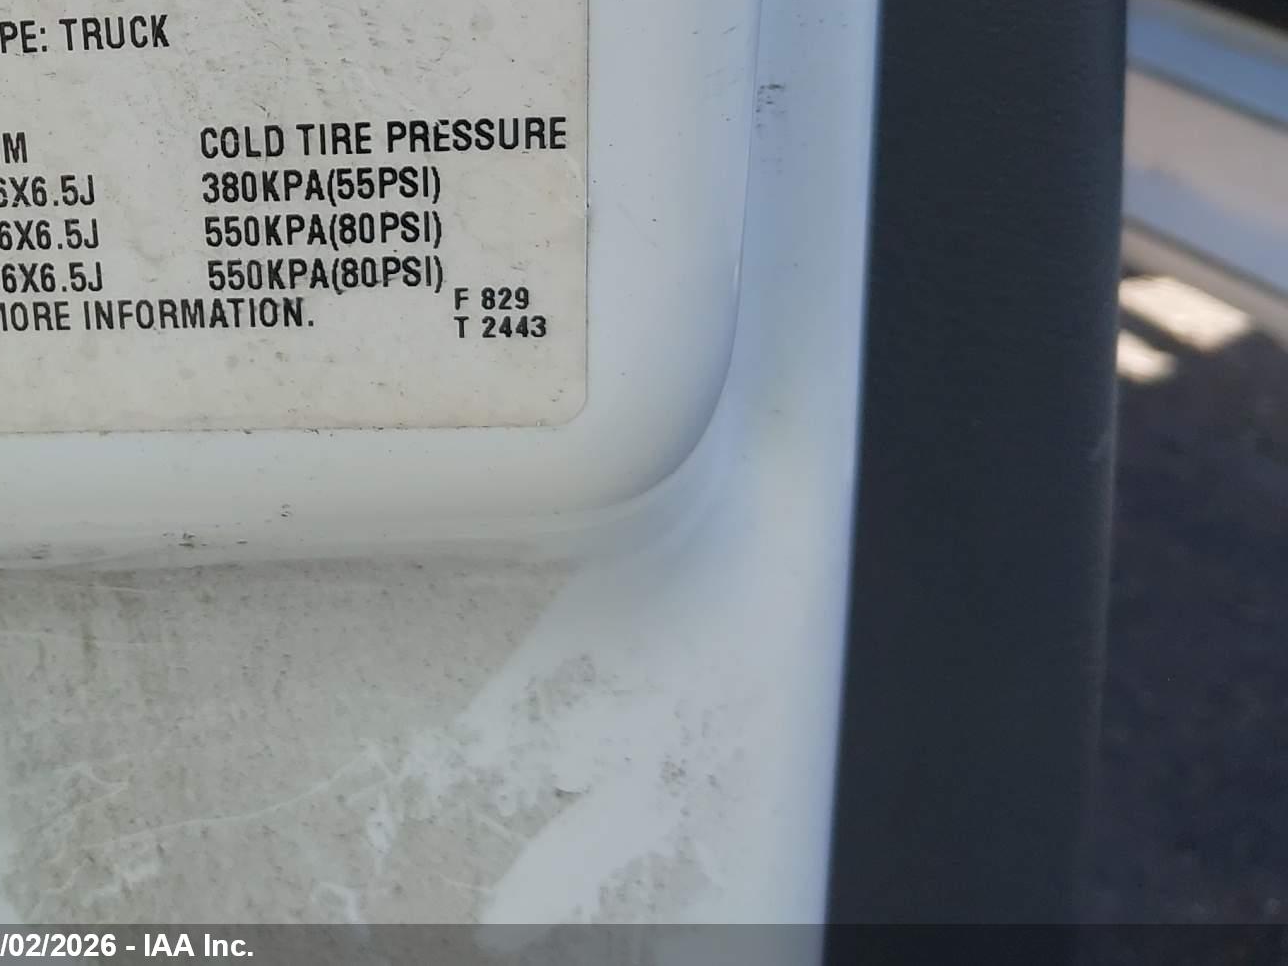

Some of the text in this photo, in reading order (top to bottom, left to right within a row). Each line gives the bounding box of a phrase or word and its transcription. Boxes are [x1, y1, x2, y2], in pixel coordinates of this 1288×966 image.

[59, 14, 170, 51] TRUCK
[200, 117, 566, 159] COLD TIRE PRESSURE
[202, 166, 440, 207] 380KPA(55PSI)
[205, 211, 442, 251] 550KPA(80PSI)
[208, 256, 443, 295] 550KPA(80PSI)
[84, 297, 314, 330] INFORMATION.
[454, 287, 529, 310] F 829
[454, 316, 547, 338] T 2443
